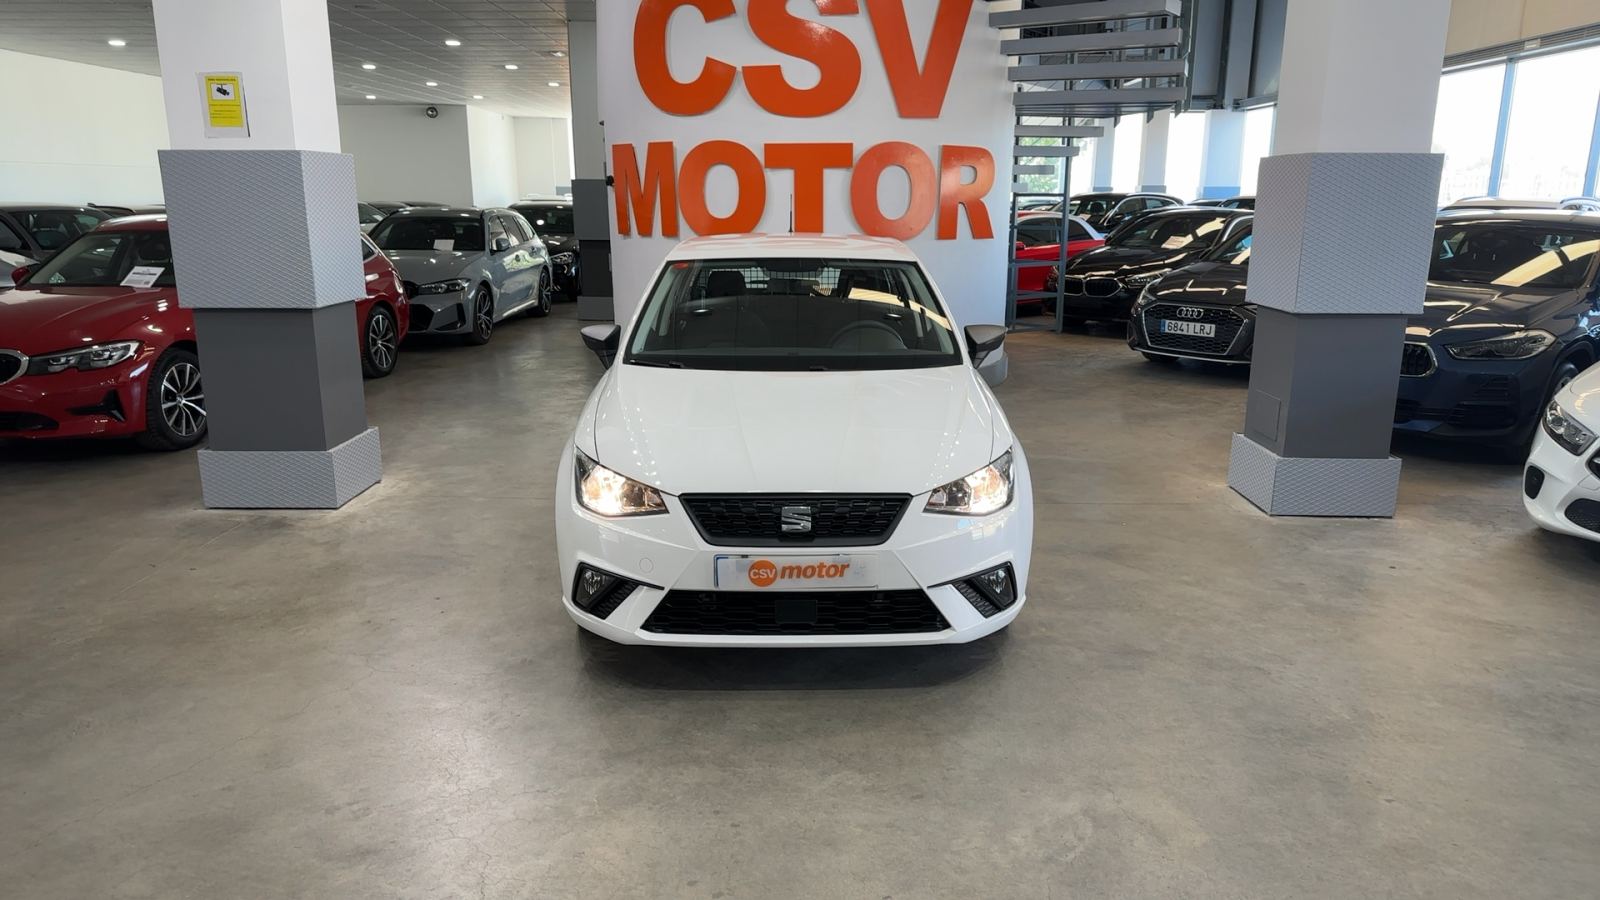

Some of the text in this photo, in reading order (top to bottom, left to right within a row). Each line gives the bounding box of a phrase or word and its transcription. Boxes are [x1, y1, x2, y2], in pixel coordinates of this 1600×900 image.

[633, 0, 974, 119] CSV
[612, 140, 996, 240] MOTOR
[1167, 321, 1213, 336] 6841 LRJ
[750, 562, 850, 580] CSV motor
